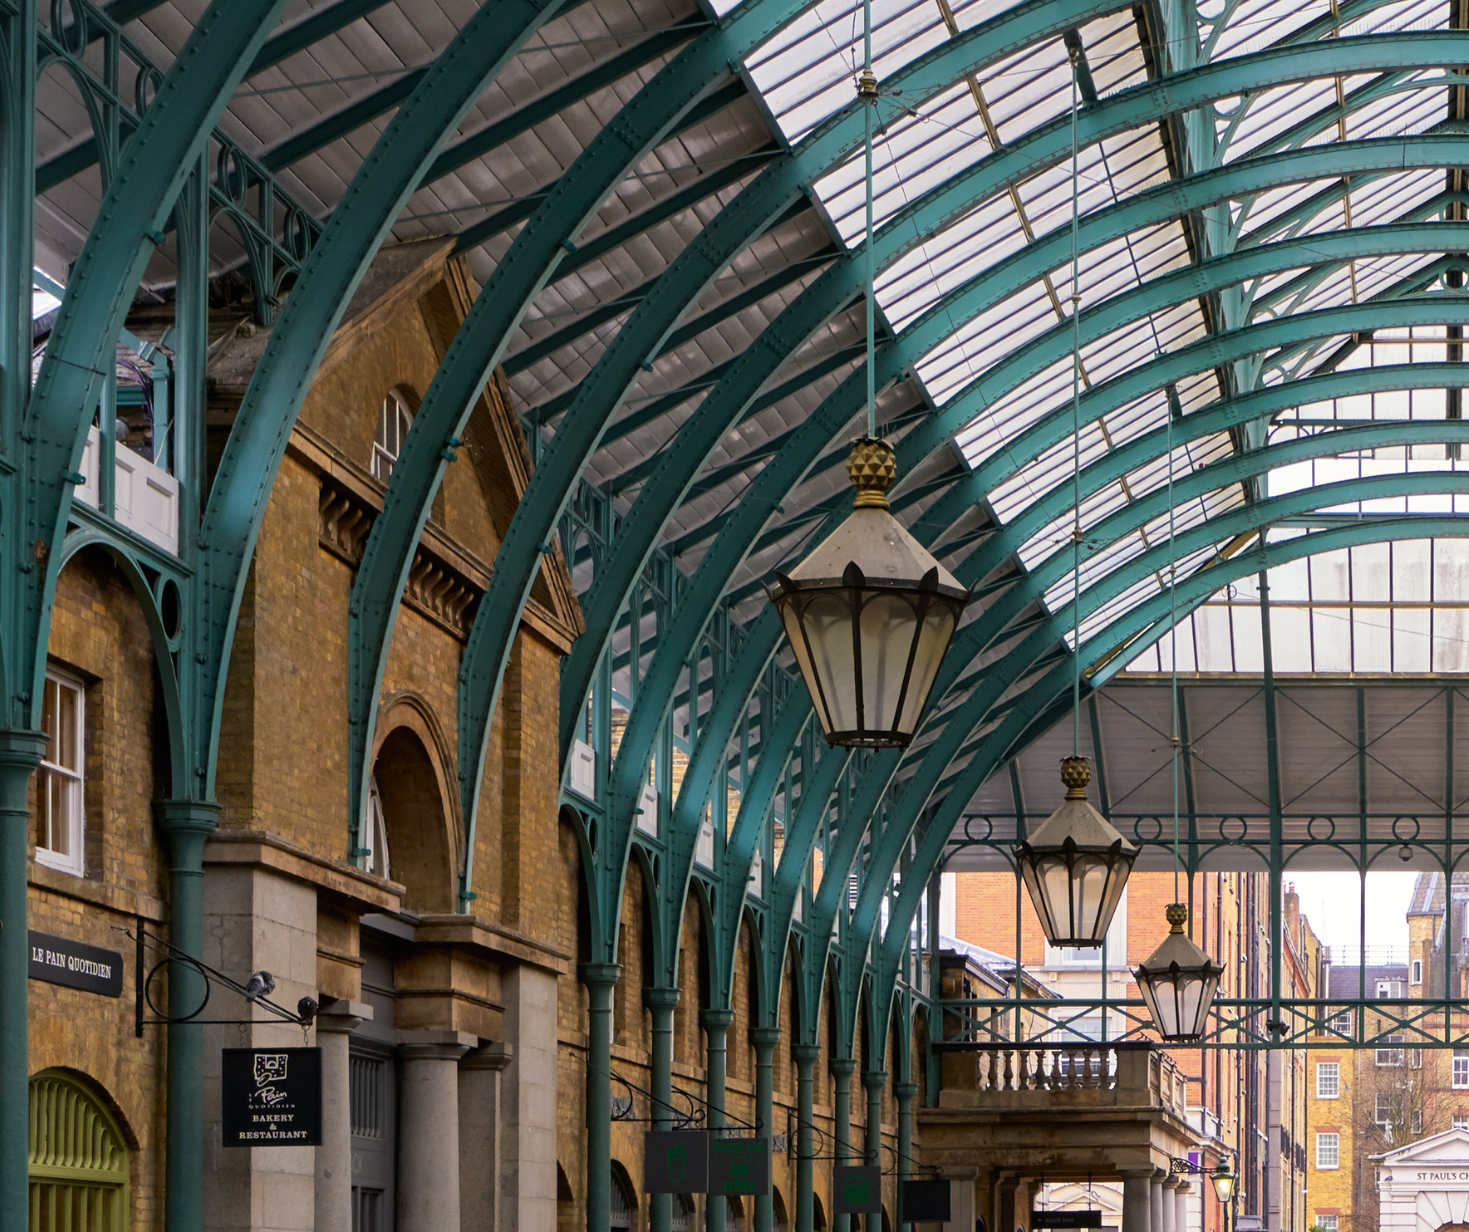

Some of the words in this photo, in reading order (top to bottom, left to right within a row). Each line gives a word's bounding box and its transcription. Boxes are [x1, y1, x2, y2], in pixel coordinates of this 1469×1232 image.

[32, 947, 44, 963] LE
[46, 950, 66, 968] PAIN
[68, 956, 112, 979] QUOTIDIEN
[255, 1086, 287, 1104] Pain
[252, 1114, 294, 1122] BAKERY
[239, 1131, 307, 1139] RESTAURANT
[713, 1143, 743, 1153] PICK
[749, 1143, 766, 1153] UP
[1417, 1172, 1427, 1180] ST
[1430, 1172, 1457, 1180] PAUL'S
[723, 1181, 756, 1192] HERE
